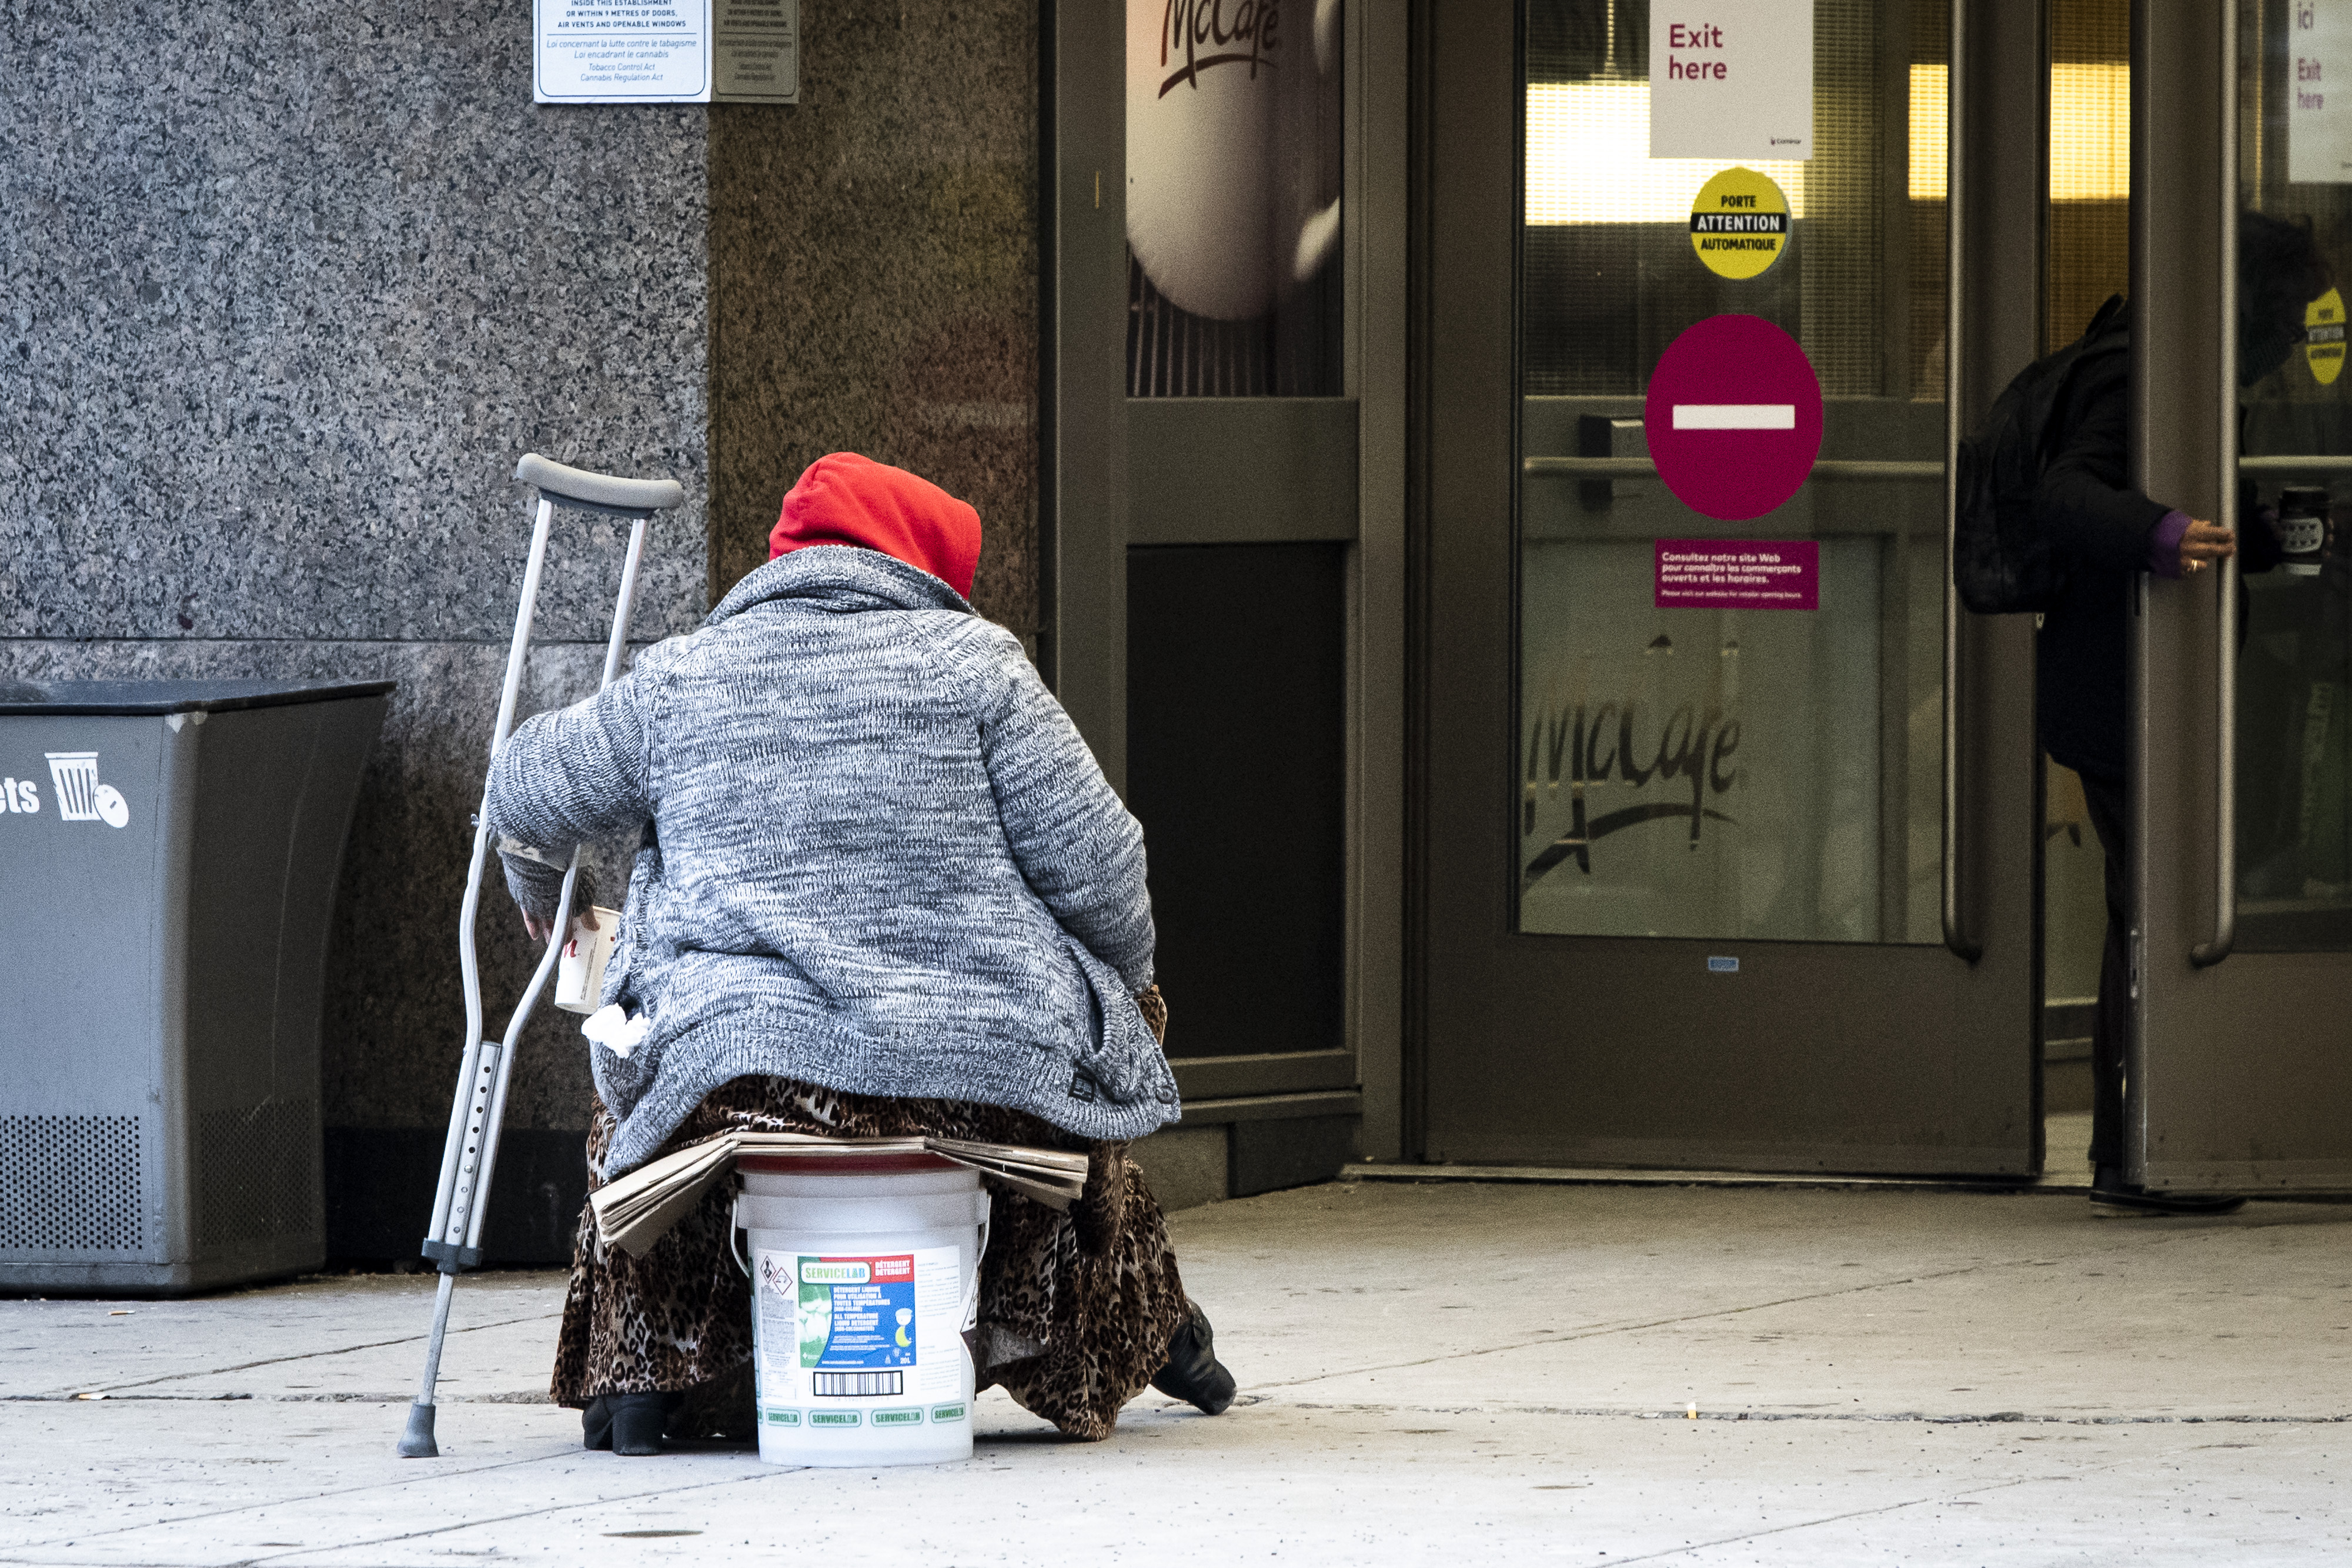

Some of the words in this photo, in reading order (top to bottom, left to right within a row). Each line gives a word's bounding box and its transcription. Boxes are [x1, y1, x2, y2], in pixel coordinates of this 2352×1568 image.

[1669, 23, 1723, 49] Exit
[659, 39, 697, 49] tabagisme
[574, 50, 586, 58] Loi
[1669, 55, 1728, 81] here
[614, 73, 650, 82] Regulation
[1720, 195, 1756, 208] PORTE
[1697, 216, 1780, 232] ATTENTION
[1700, 238, 1776, 251] AUTOMATIQUE
[1662, 552, 1709, 562] Consultez
[1711, 554, 1737, 562] notre
[1739, 553, 1757, 562] site
[1759, 553, 1780, 563] Web
[1662, 564, 1682, 573] pour
[1728, 563, 1740, 573] les
[1662, 574, 1698, 583] ouverts
[1700, 574, 1709, 583] et
[1712, 573, 1726, 583] les
[1728, 573, 1769, 584] horaires.
[875, 1259, 910, 1268] DÉTERGENT
[805, 1267, 866, 1279] SERVICELAB
[875, 1268, 910, 1276] DETERGENT
[768, 1412, 798, 1423] SERVICELAB
[813, 1414, 857, 1423] SERVICELAB
[876, 1412, 920, 1422] SERVICELAB
